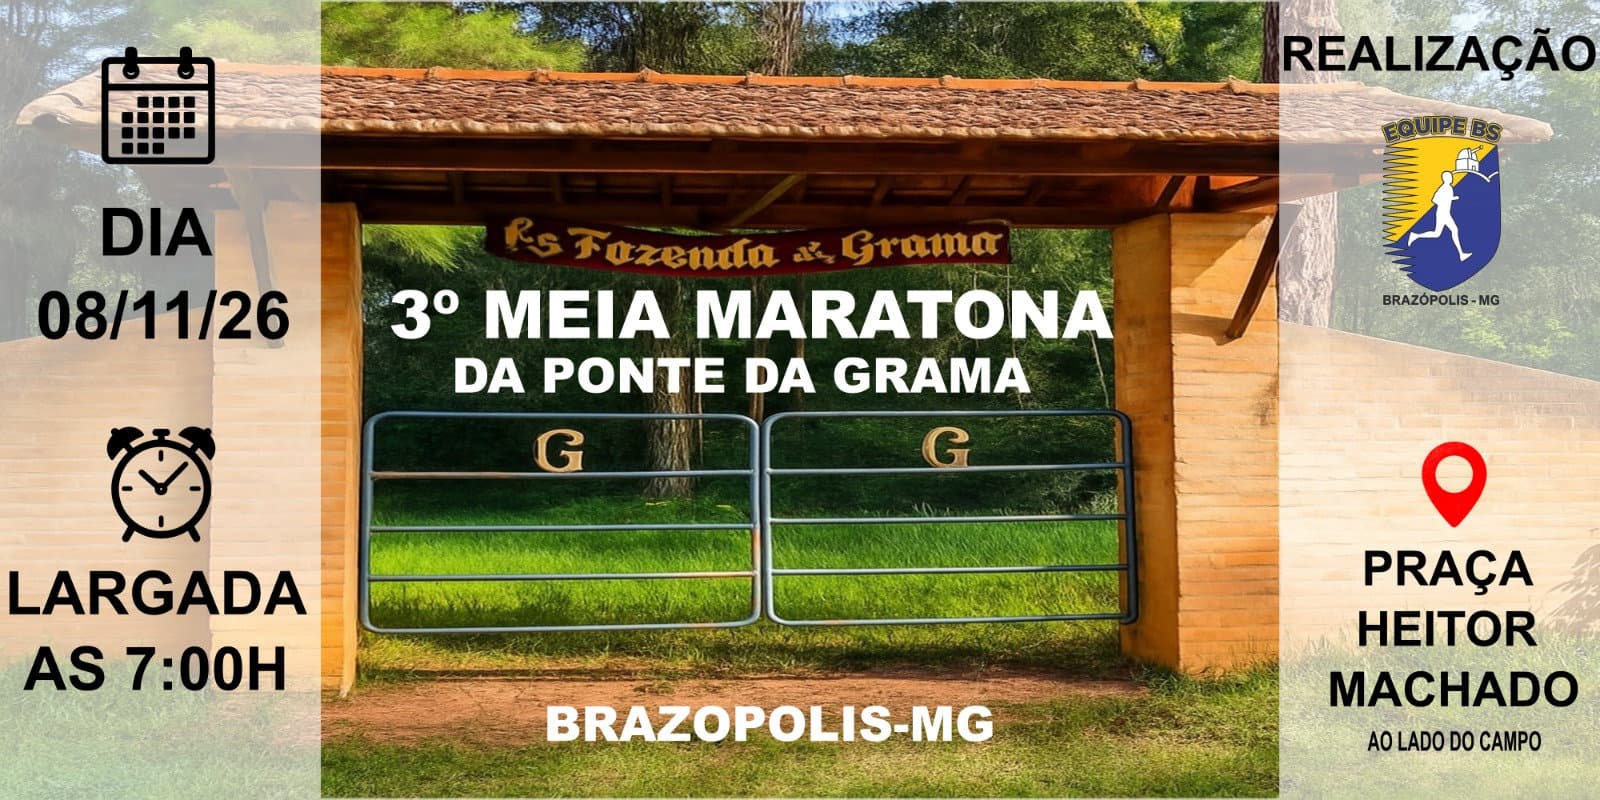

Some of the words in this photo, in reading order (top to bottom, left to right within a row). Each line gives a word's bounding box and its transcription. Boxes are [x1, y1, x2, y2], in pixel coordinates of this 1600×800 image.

[841, 229, 1004, 266] Grama
[533, 428, 584, 474] G
[921, 426, 970, 468] G
